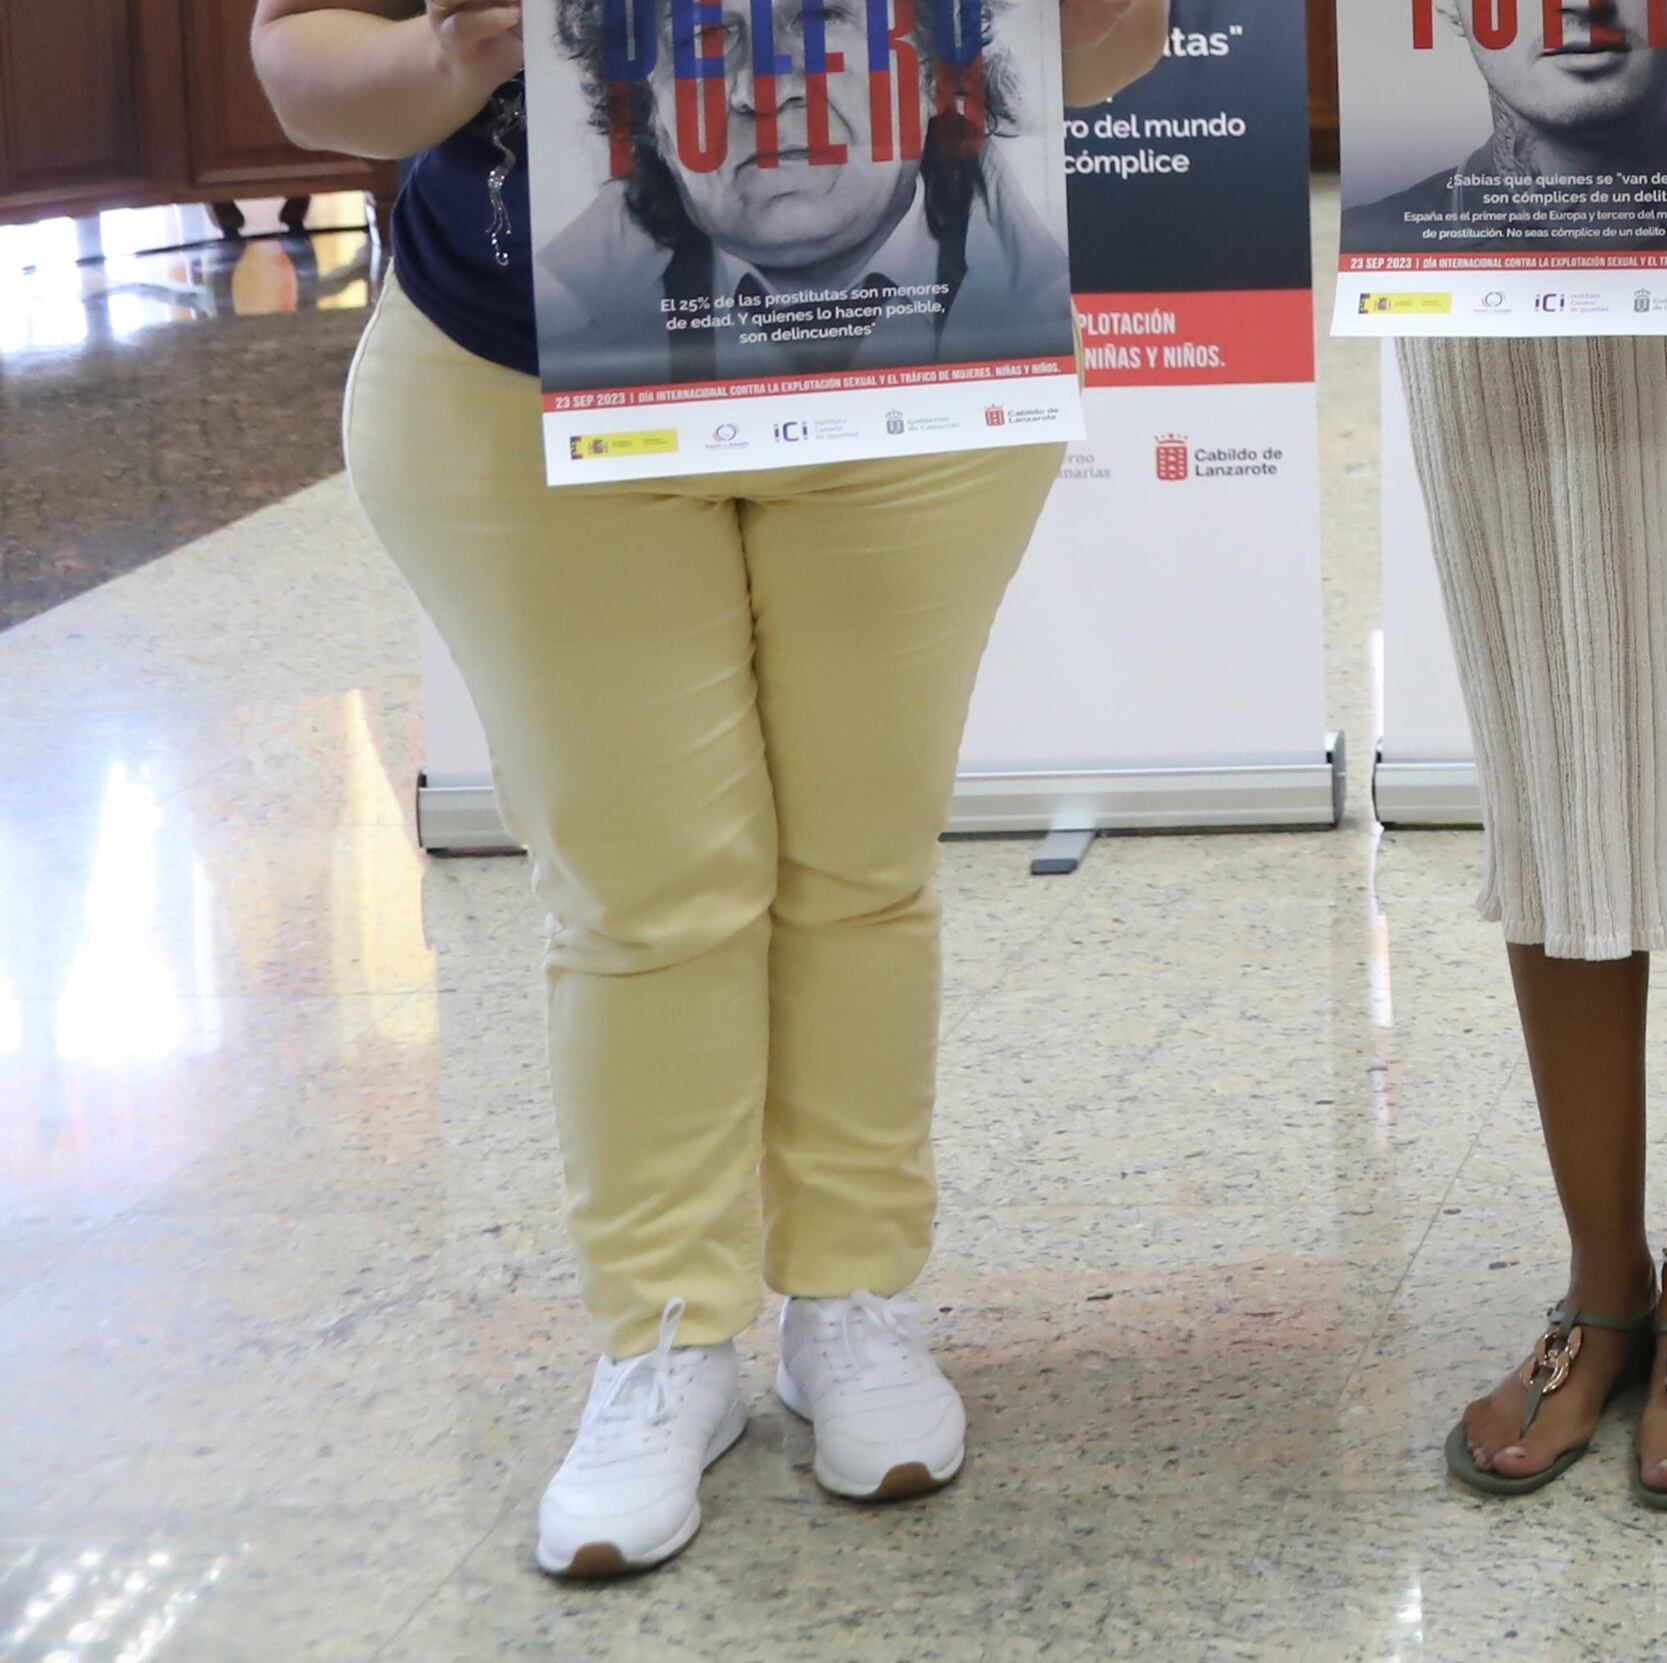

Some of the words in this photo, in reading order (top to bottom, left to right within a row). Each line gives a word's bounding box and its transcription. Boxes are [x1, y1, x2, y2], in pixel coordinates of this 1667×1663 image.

[1094, 113, 1140, 139] del
[1144, 111, 1247, 138] mundo
[1064, 149, 1191, 179] cómplice
[1446, 173, 1501, 189] ¿Sabías
[1503, 175, 1532, 189] que
[1535, 174, 1593, 188] quienes
[1596, 175, 1613, 185] se
[1616, 172, 1648, 185] "van
[1483, 194, 1509, 204] son
[1511, 190, 1587, 206] cómplices
[1590, 190, 1609, 203] de
[1612, 193, 1631, 202] un
[660, 298, 677, 312] El
[679, 296, 710, 313] 25%
[713, 295, 735, 308] de
[738, 294, 761, 307] las
[764, 289, 848, 308] prostitutas
[850, 288, 879, 300] son
[881, 283, 949, 298] menores
[666, 316, 687, 330] de
[690, 313, 734, 329] edad.
[737, 312, 748, 325] Y
[751, 310, 814, 327] quienes
[816, 307, 832, 320] lo
[835, 305, 882, 319] hacen
[886, 300, 945, 318] posible,
[1079, 308, 1176, 335] PLOTACIÓN
[739, 332, 767, 343] son
[1085, 343, 1142, 370] NIÑAS
[1145, 347, 1159, 369] Y
[1163, 342, 1226, 368] NIÑOS.
[1195, 448, 1257, 462] Cabildo
[1263, 448, 1283, 461] de
[1195, 464, 1278, 478] Lanzarote
